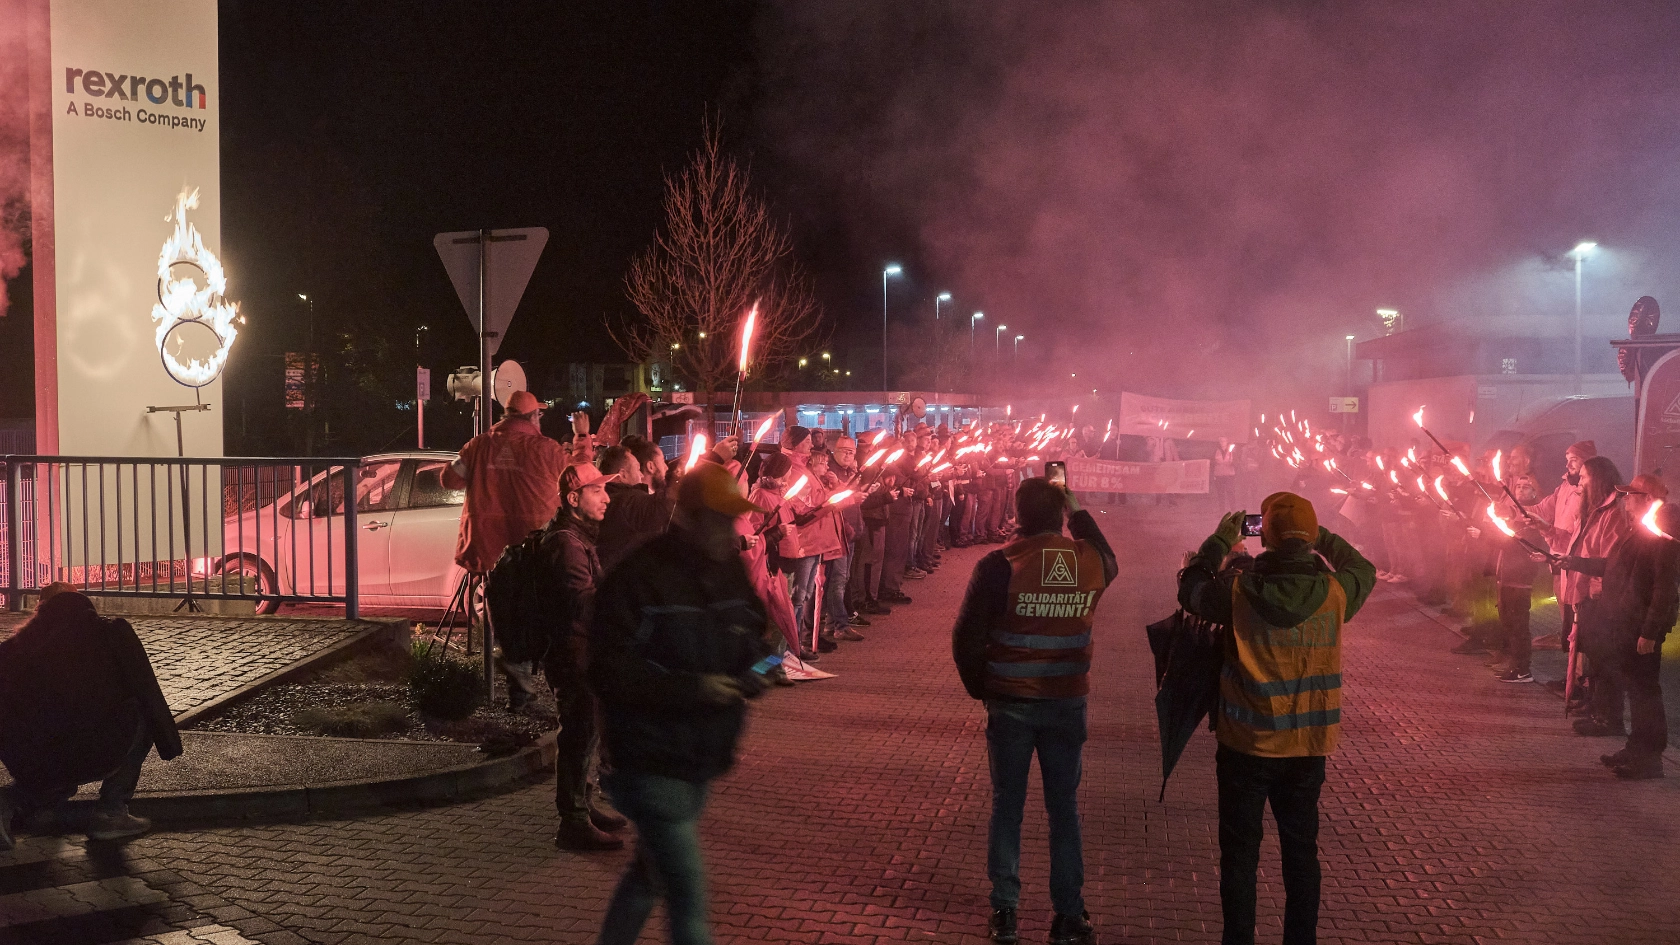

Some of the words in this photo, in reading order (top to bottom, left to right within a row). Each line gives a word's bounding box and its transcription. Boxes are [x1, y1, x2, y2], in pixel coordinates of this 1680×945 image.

[66, 67, 206, 110] rexroth
[66, 101, 79, 116] A
[84, 103, 131, 121] Bosch
[137, 109, 206, 132] Company
[1071, 462, 1141, 475] GEMEINSAM
[1072, 473, 1098, 488] FÜR
[1018, 591, 1086, 604] SOLIDARITÄT
